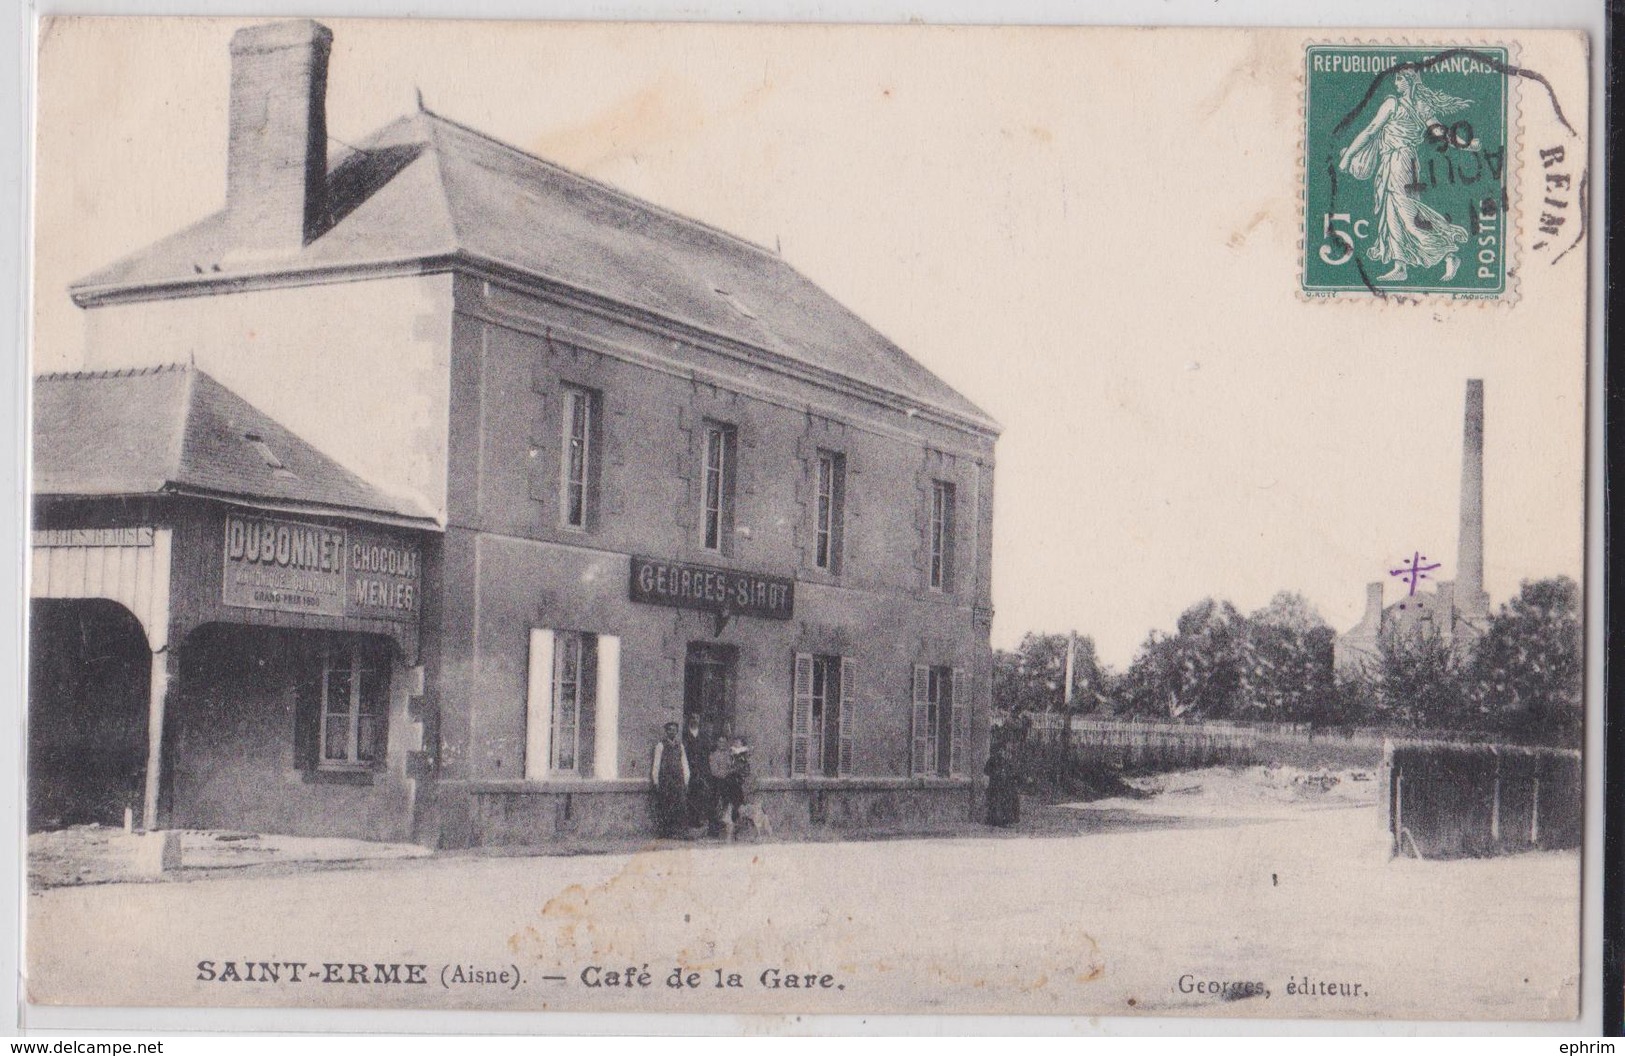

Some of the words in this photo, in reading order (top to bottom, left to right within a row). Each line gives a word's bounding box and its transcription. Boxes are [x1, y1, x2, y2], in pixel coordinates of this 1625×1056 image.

[229, 518, 343, 574] DUBONNET
[353, 543, 417, 579] CHOCOLAT
[355, 578, 414, 612] MENIER
[196, 960, 428, 985] SAINT-ERME
[580, 963, 652, 988] Café
[666, 966, 700, 989] de
[714, 966, 744, 989] la
[759, 968, 846, 990] Gare.
[1178, 974, 1272, 999] Georges,
[1286, 974, 1369, 997] éditeur.
